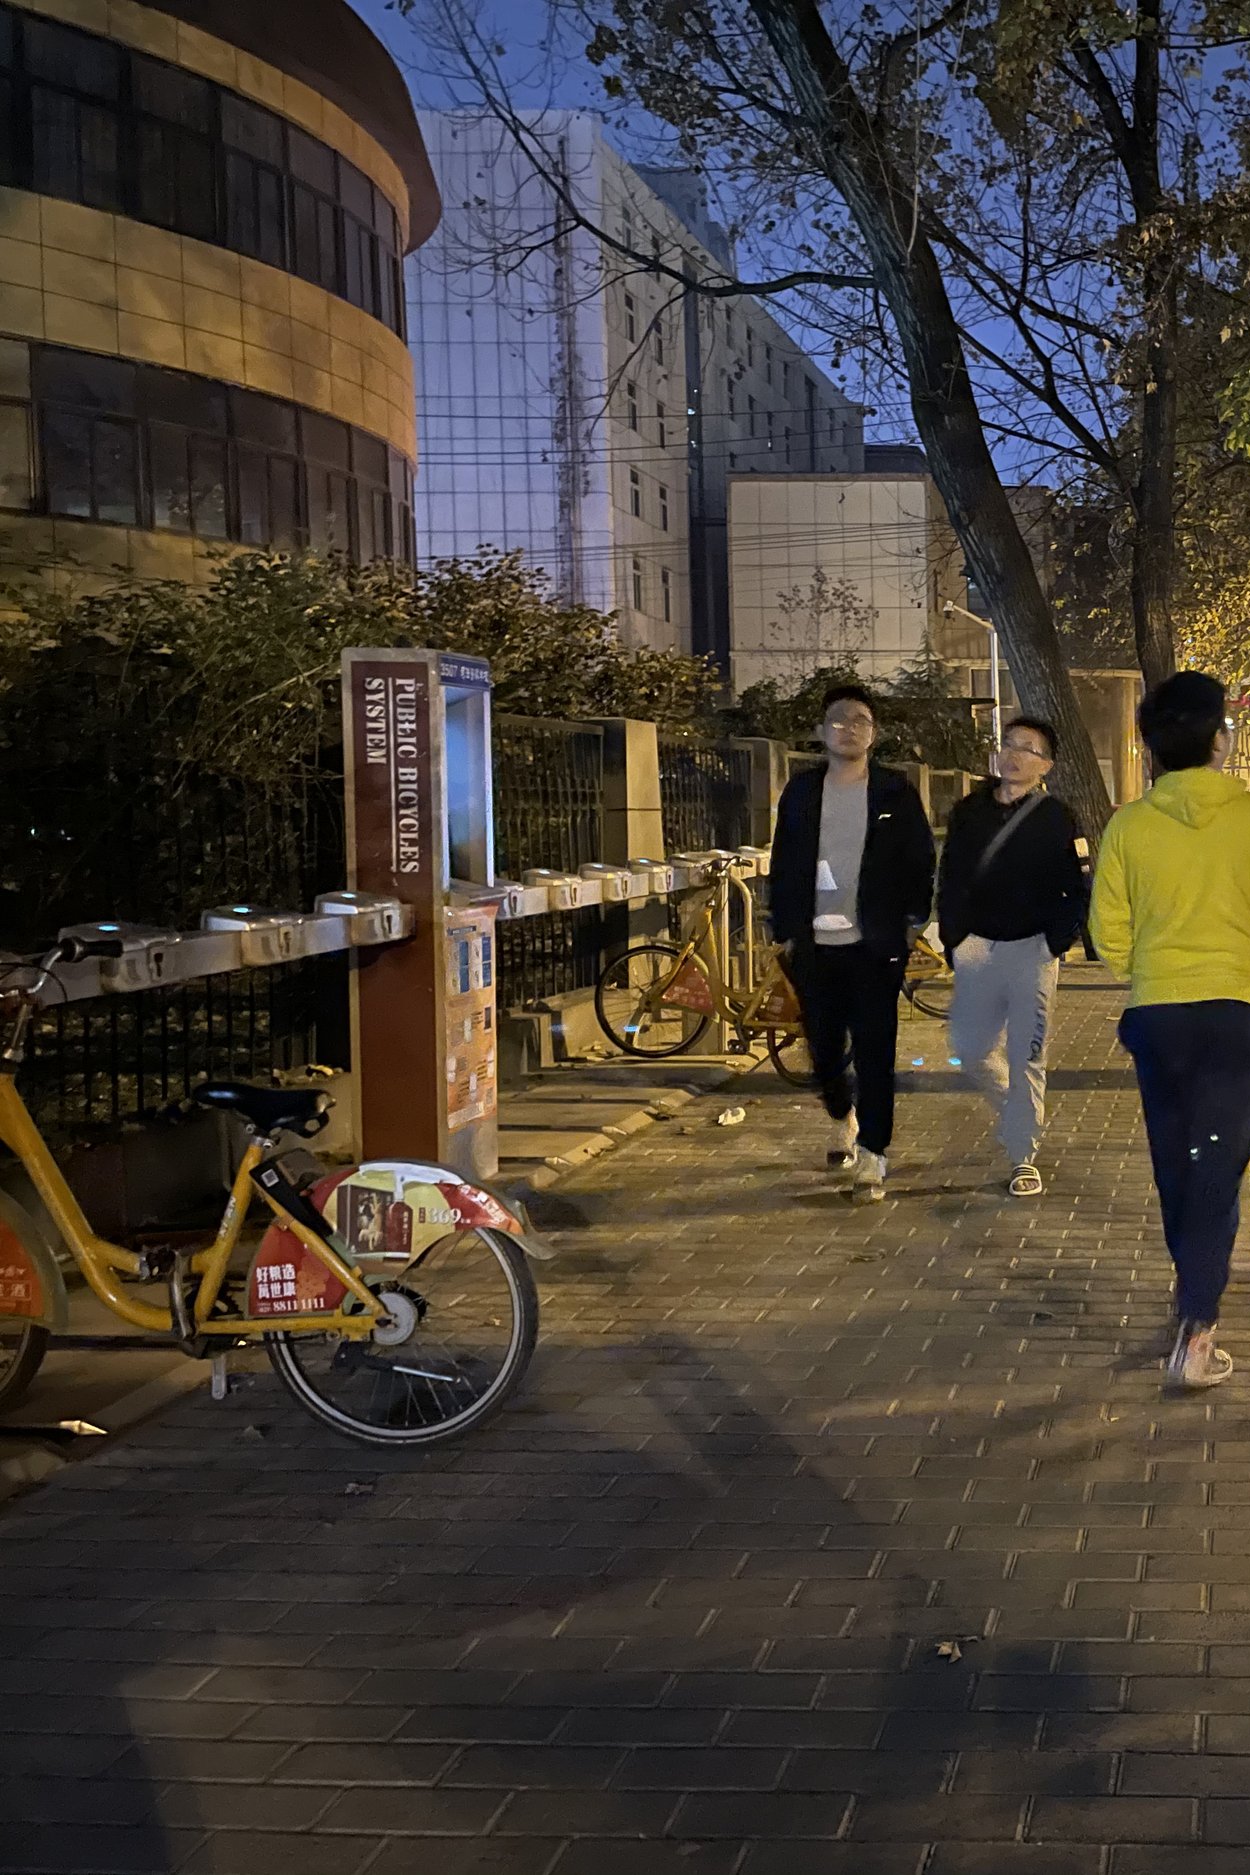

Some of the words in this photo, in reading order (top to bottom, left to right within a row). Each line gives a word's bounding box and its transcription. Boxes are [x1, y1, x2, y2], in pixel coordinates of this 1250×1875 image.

[364, 676, 388, 765] SYSTEM
[395, 677, 418, 760] PUBLIC
[397, 766, 420, 874] BICYCLES
[428, 1207, 462, 1224] 369
